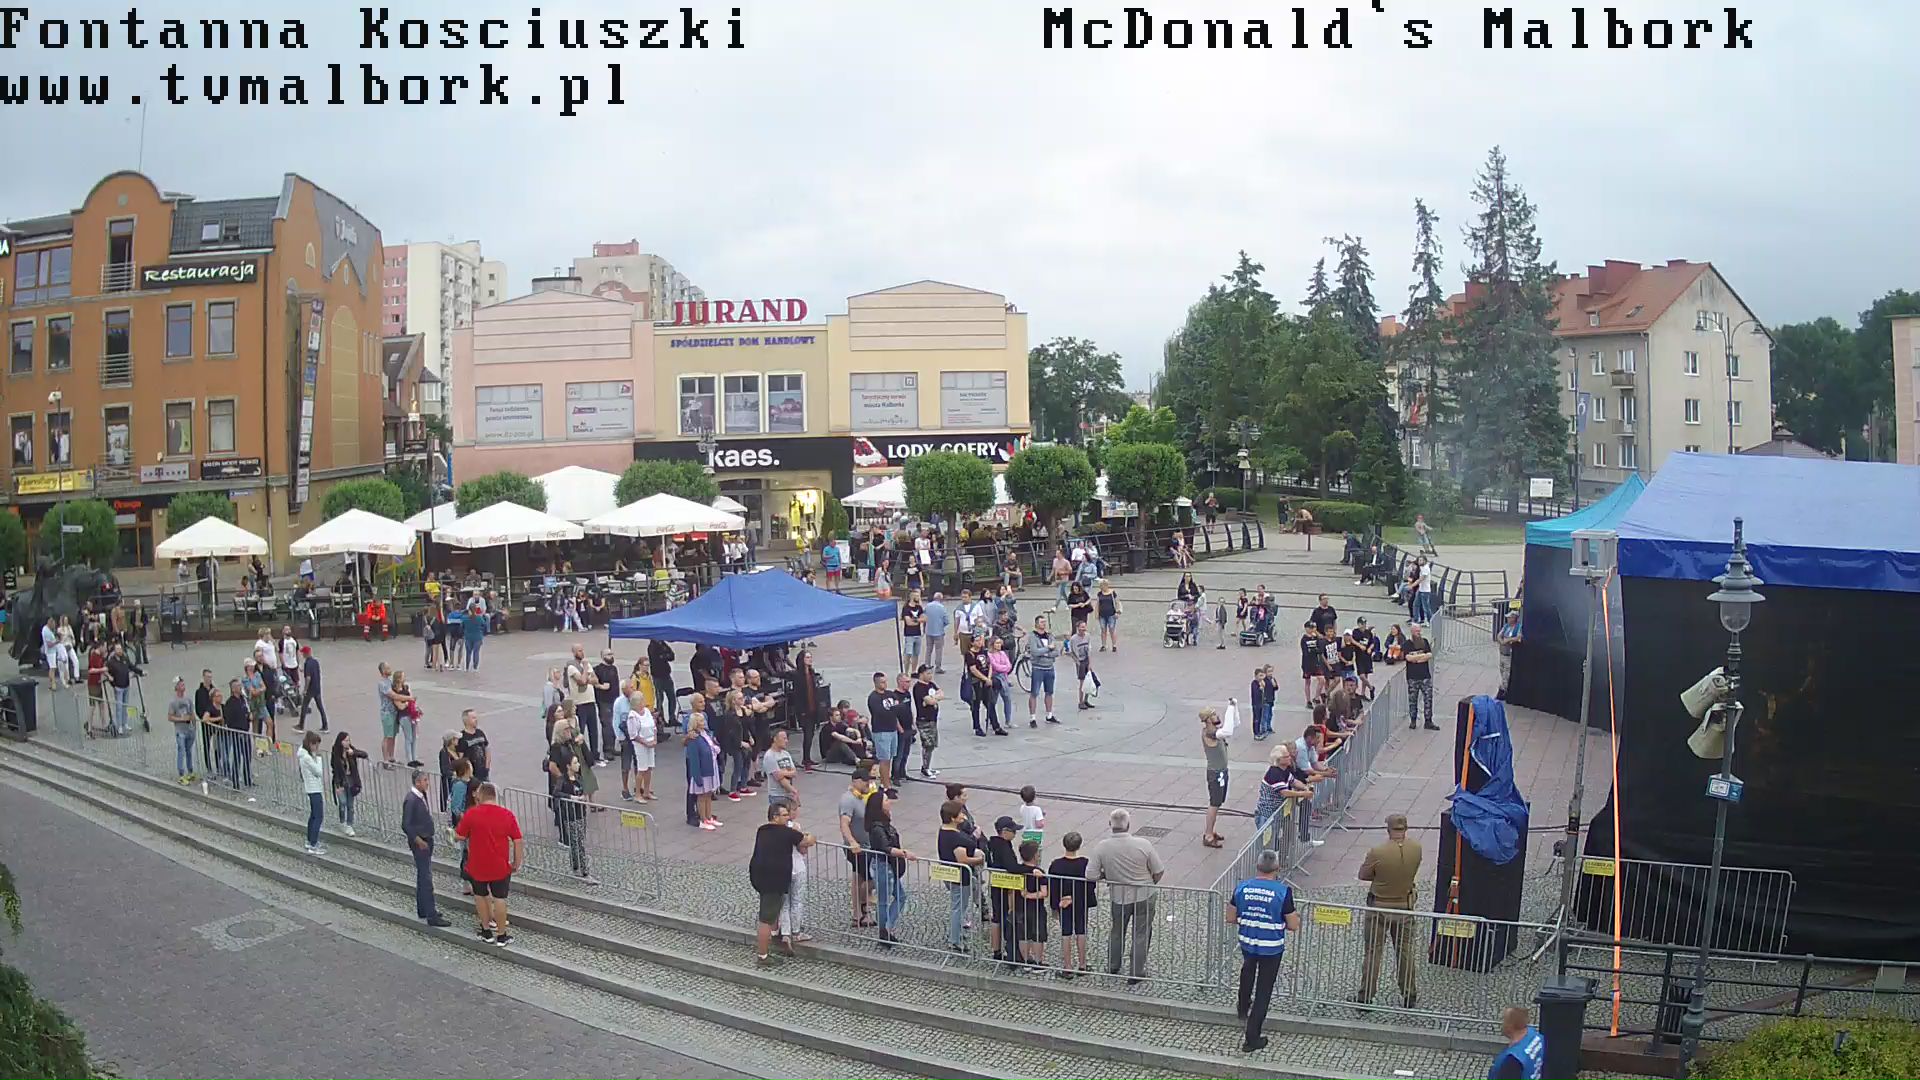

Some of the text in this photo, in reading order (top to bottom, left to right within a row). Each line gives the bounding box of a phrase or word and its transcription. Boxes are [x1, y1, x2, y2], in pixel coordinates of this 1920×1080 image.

[144, 260, 254, 281] Restauracja
[674, 298, 808, 326] JURAND
[738, 337, 760, 346] DOM
[764, 335, 815, 346] HANDLOWY
[888, 443, 934, 459] LODY
